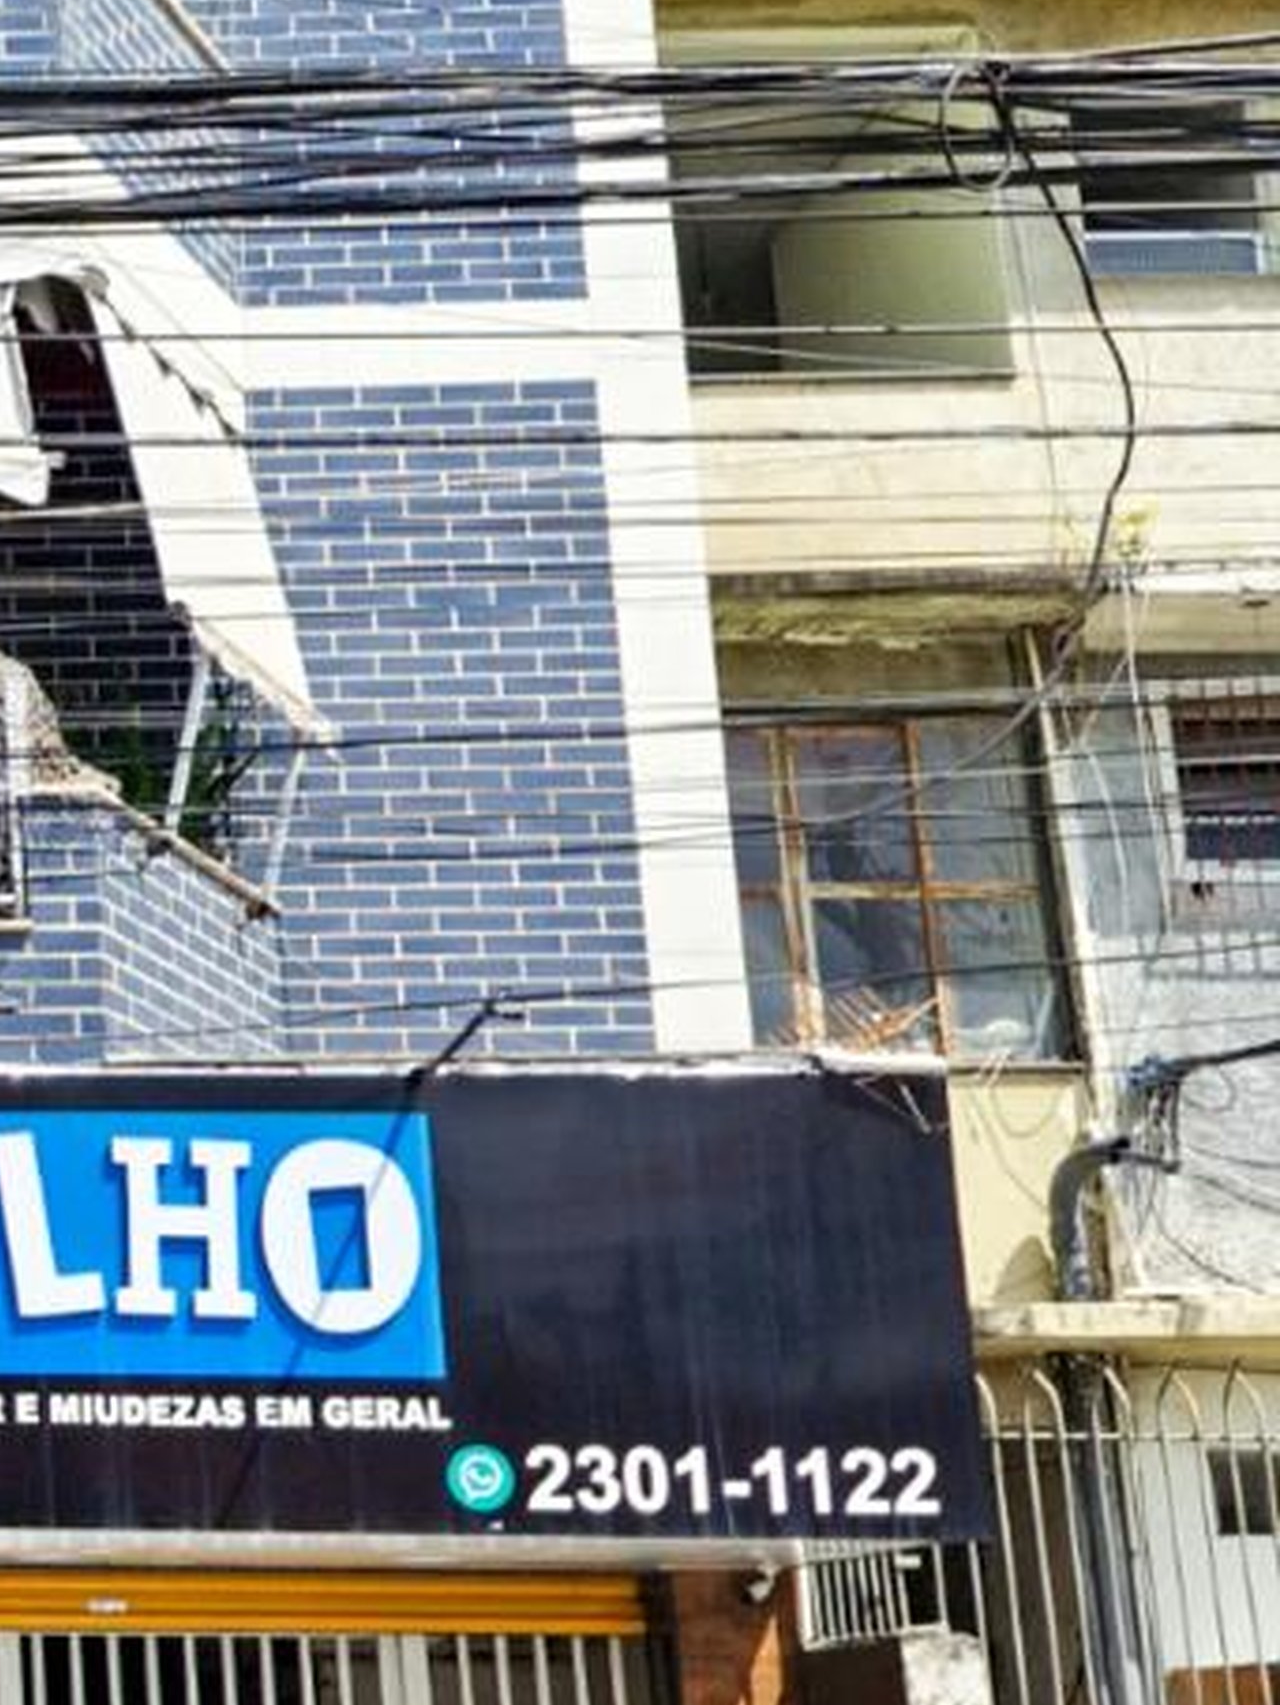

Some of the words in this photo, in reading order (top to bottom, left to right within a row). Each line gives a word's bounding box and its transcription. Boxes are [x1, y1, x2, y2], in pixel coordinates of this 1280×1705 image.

[14, 1392, 40, 1424] E
[48, 1393, 246, 1428] MIUDEZAS
[254, 1396, 314, 1429] EM
[321, 1396, 453, 1431] GERAL
[523, 1443, 942, 1517] 2301-1122
